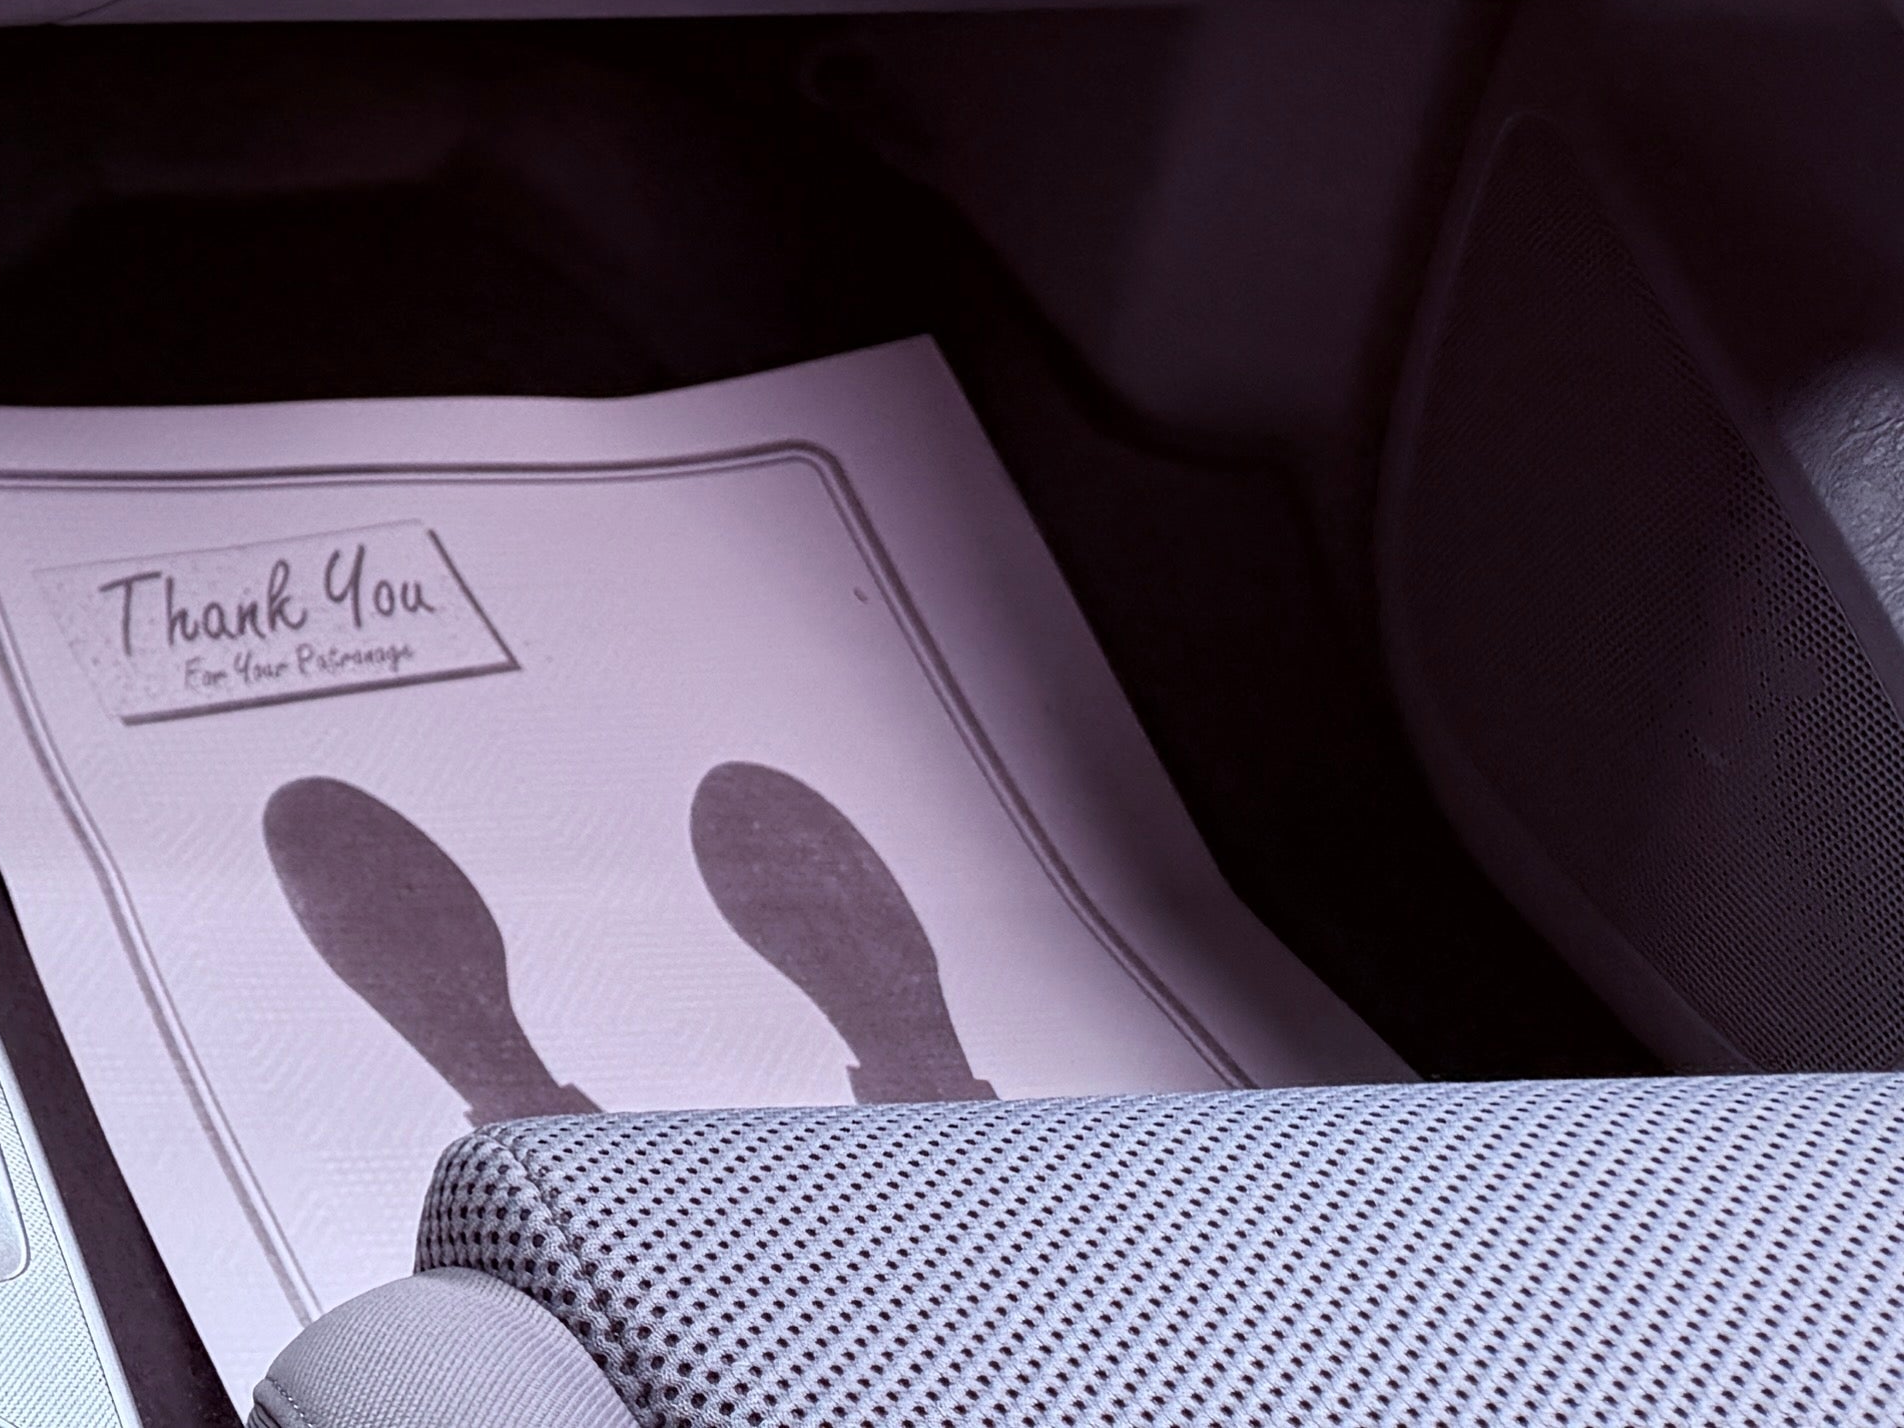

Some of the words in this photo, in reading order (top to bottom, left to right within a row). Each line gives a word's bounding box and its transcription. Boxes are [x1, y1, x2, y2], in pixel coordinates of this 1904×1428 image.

[100, 558, 309, 657] Thank
[323, 545, 436, 628] You
[183, 659, 229, 690] For
[234, 652, 290, 685] Your
